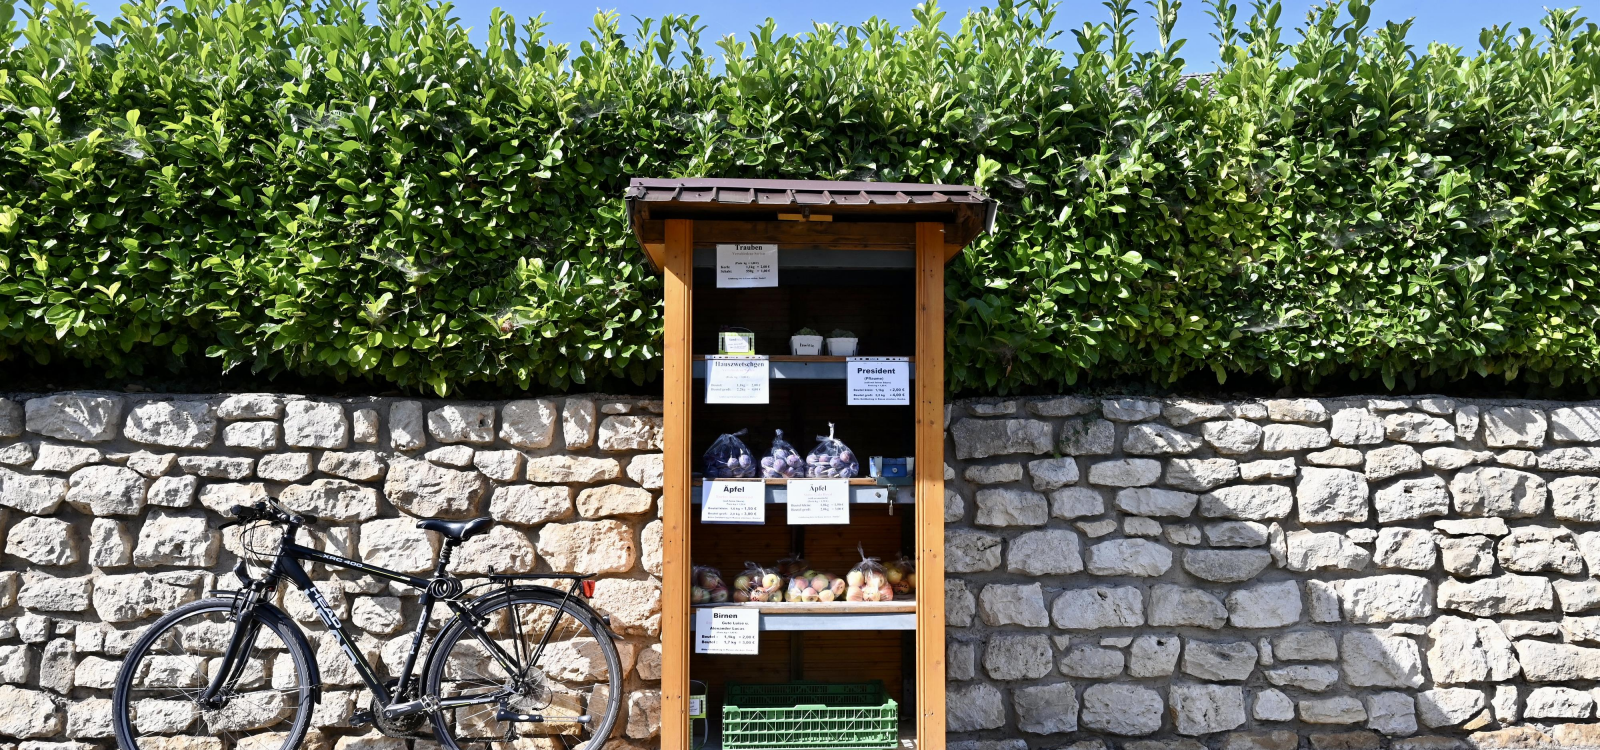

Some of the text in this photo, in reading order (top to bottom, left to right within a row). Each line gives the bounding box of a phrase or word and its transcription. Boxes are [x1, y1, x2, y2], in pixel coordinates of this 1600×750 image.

[724, 485, 744, 493] Äpfel
[809, 484, 826, 492] Äpfel
[322, 554, 342, 562] XRC
[310, 586, 342, 629] HEAD
